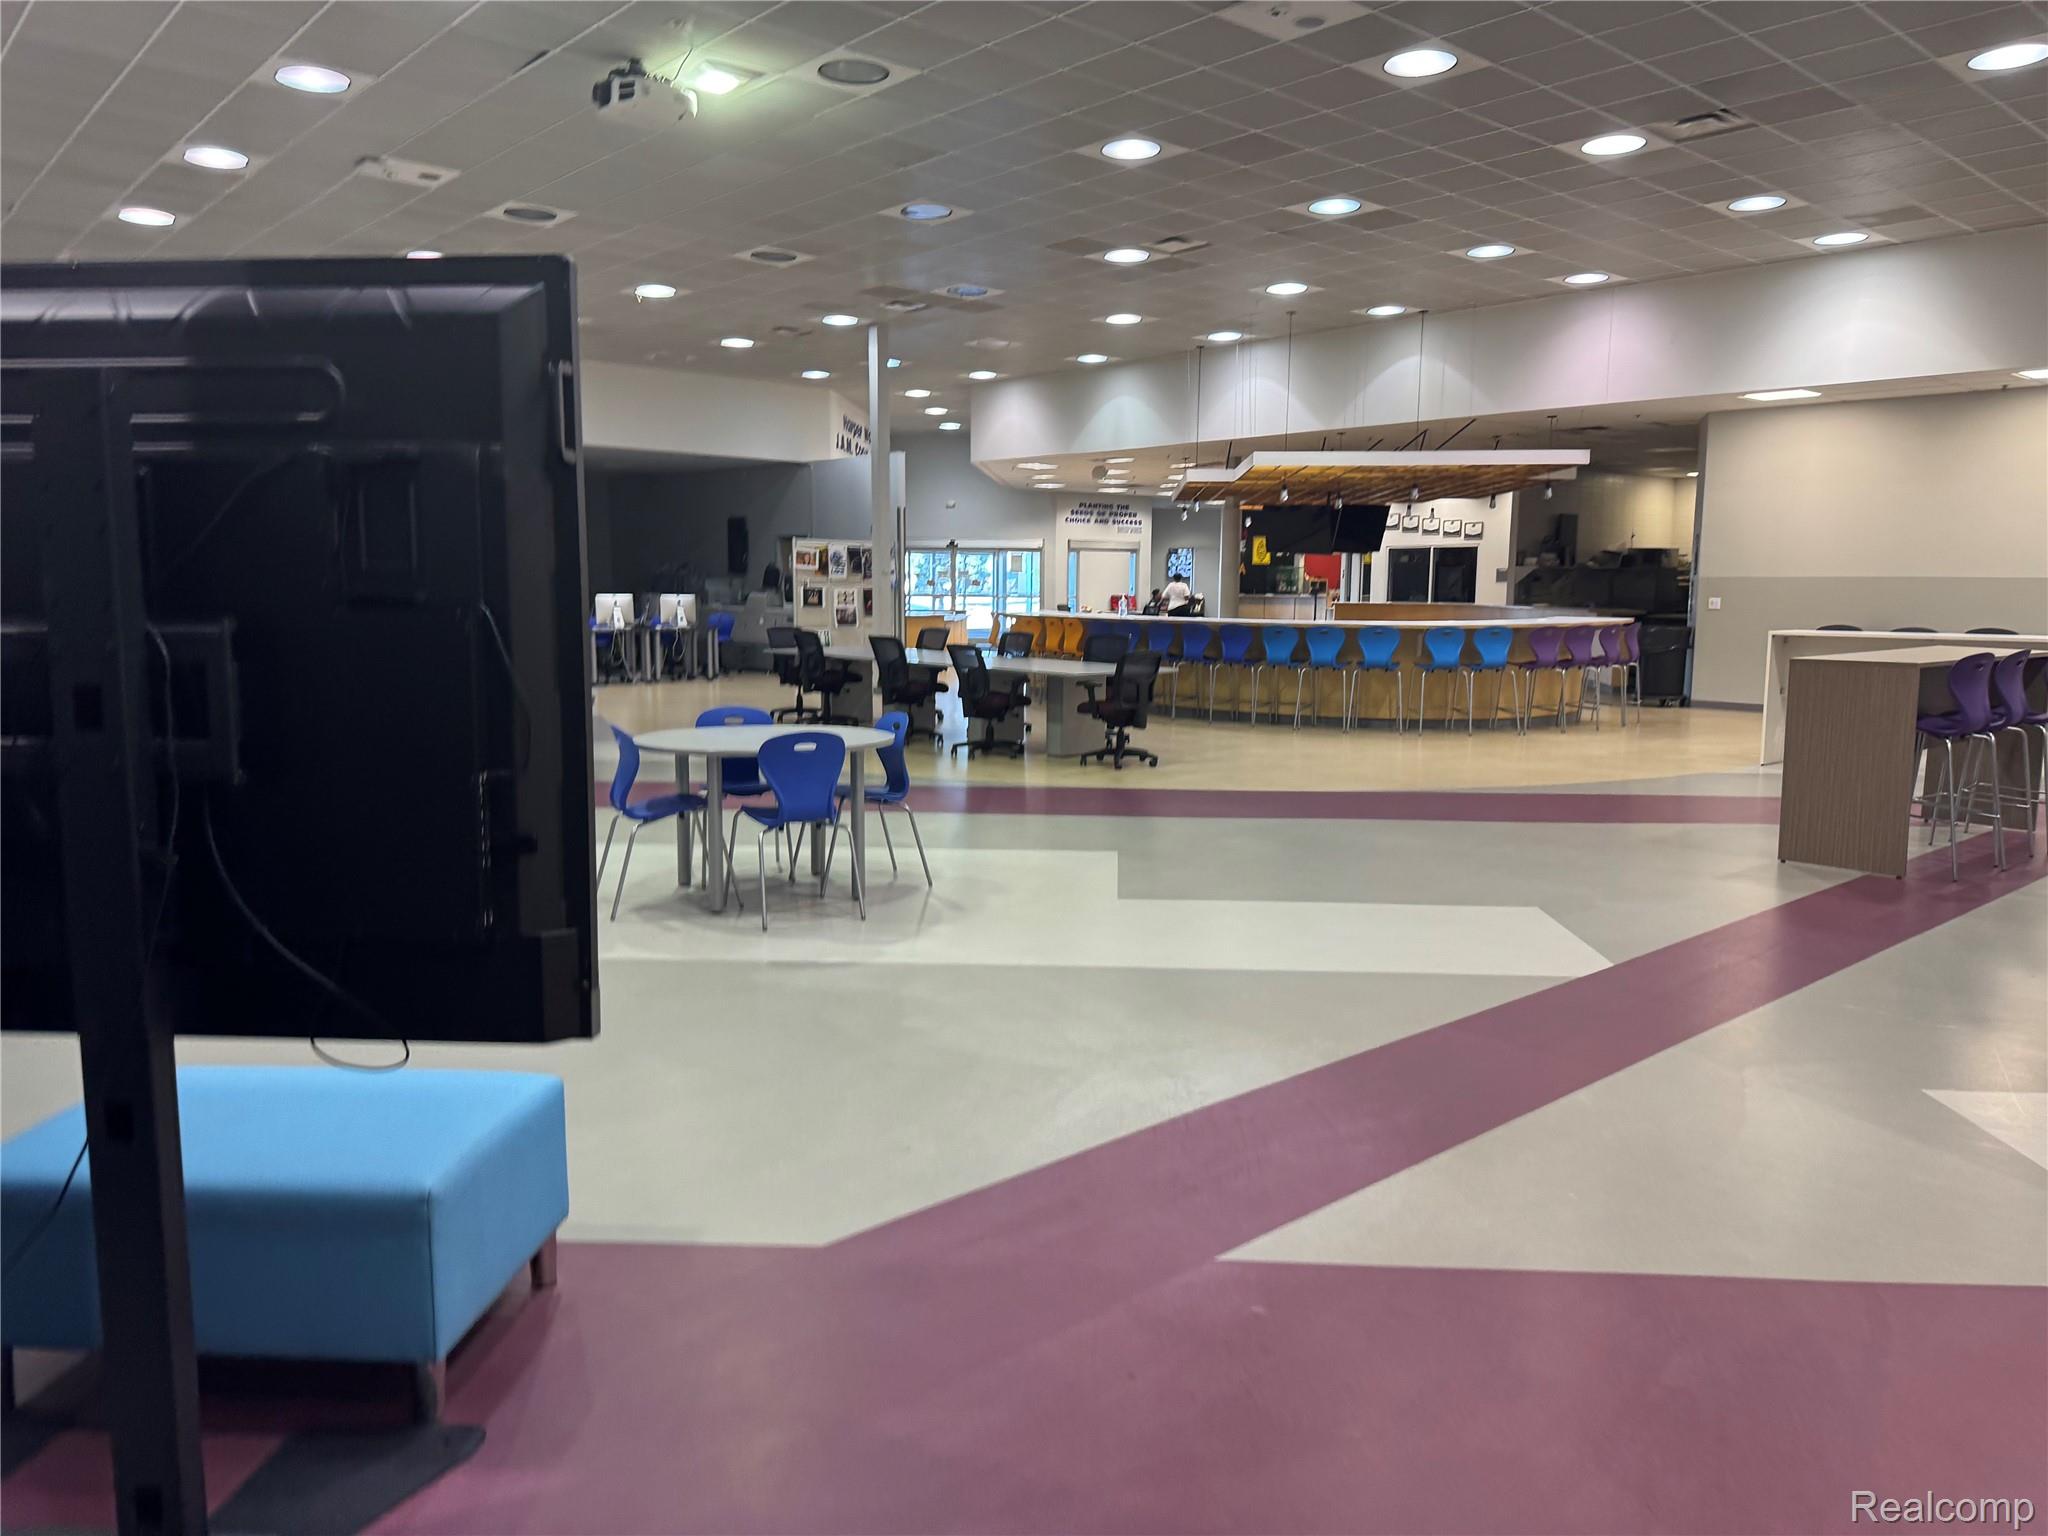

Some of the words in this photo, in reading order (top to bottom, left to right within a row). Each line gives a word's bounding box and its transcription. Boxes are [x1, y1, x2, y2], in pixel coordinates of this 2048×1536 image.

[1078, 502, 1114, 510] PLANTING
[1070, 509, 1094, 517] SEEDS
[1065, 516, 1091, 524] CHOICE
[1112, 518, 1143, 526] SUCCESS
